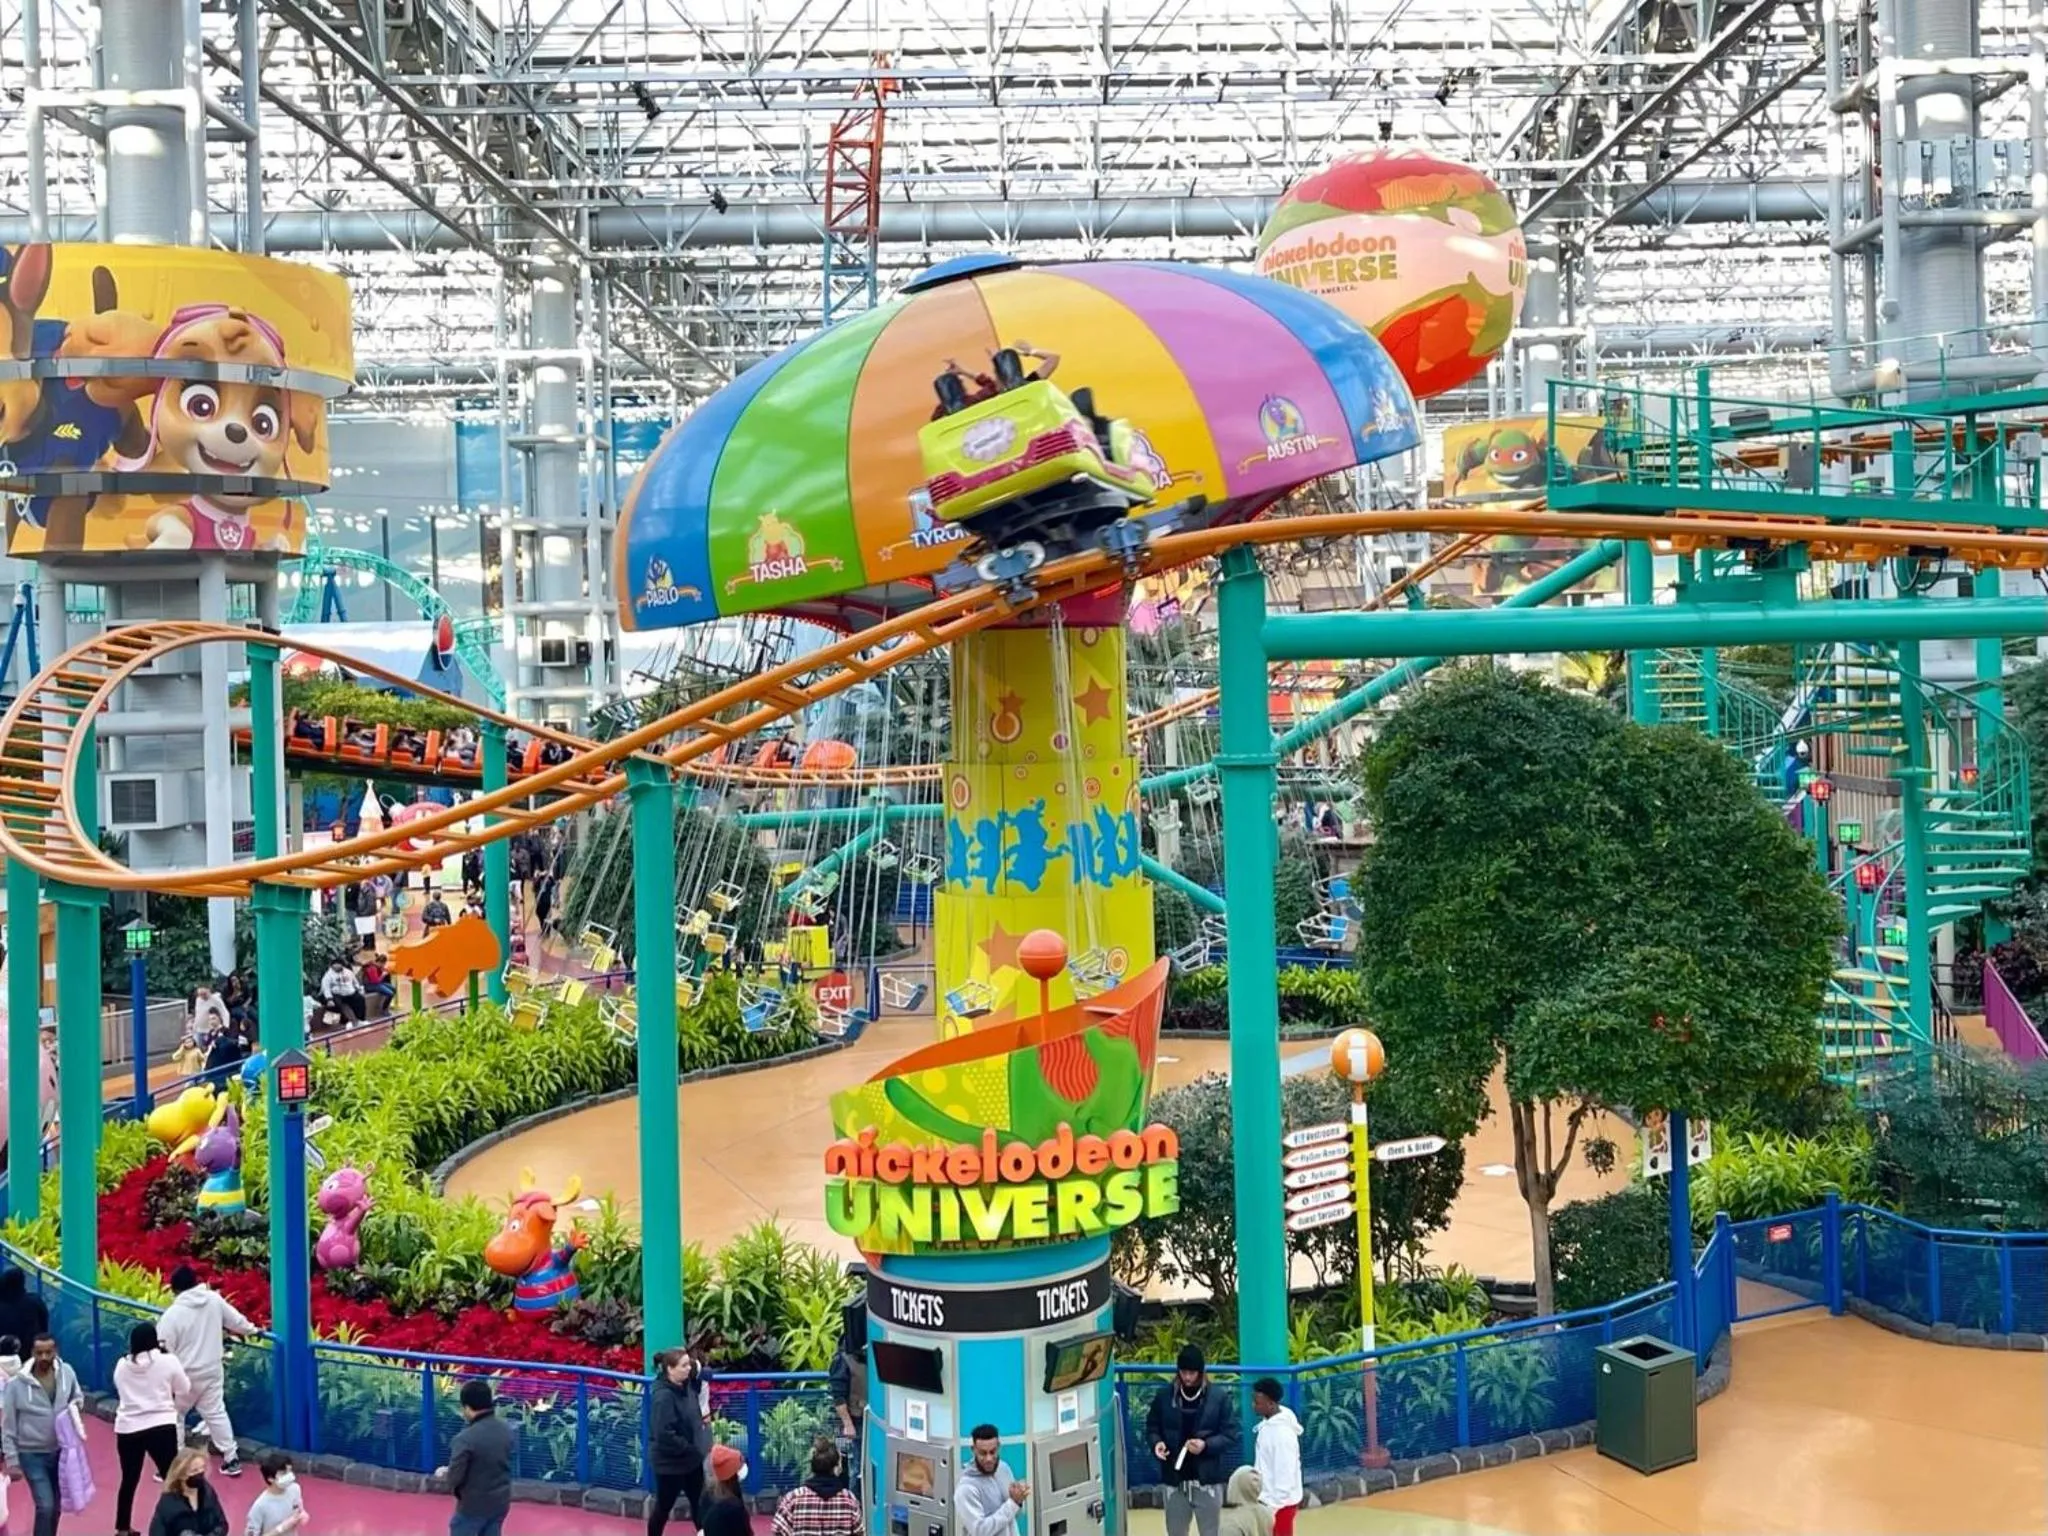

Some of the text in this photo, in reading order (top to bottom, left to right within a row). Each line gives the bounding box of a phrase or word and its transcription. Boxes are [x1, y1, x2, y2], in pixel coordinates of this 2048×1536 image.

[1264, 232, 1397, 274] nickelodeon
[1264, 254, 1398, 290] NIVERSE
[1266, 434, 1319, 463] AUSTIN
[750, 556, 809, 584] TASHA
[646, 585, 680, 608] PABLO
[818, 985, 852, 1001] EXIT
[824, 1122, 1180, 1187] nickelodeon
[824, 1160, 1181, 1243] UNIVERSE
[890, 1287, 945, 1327] TICKETS
[1036, 1279, 1090, 1322] TICKETS
